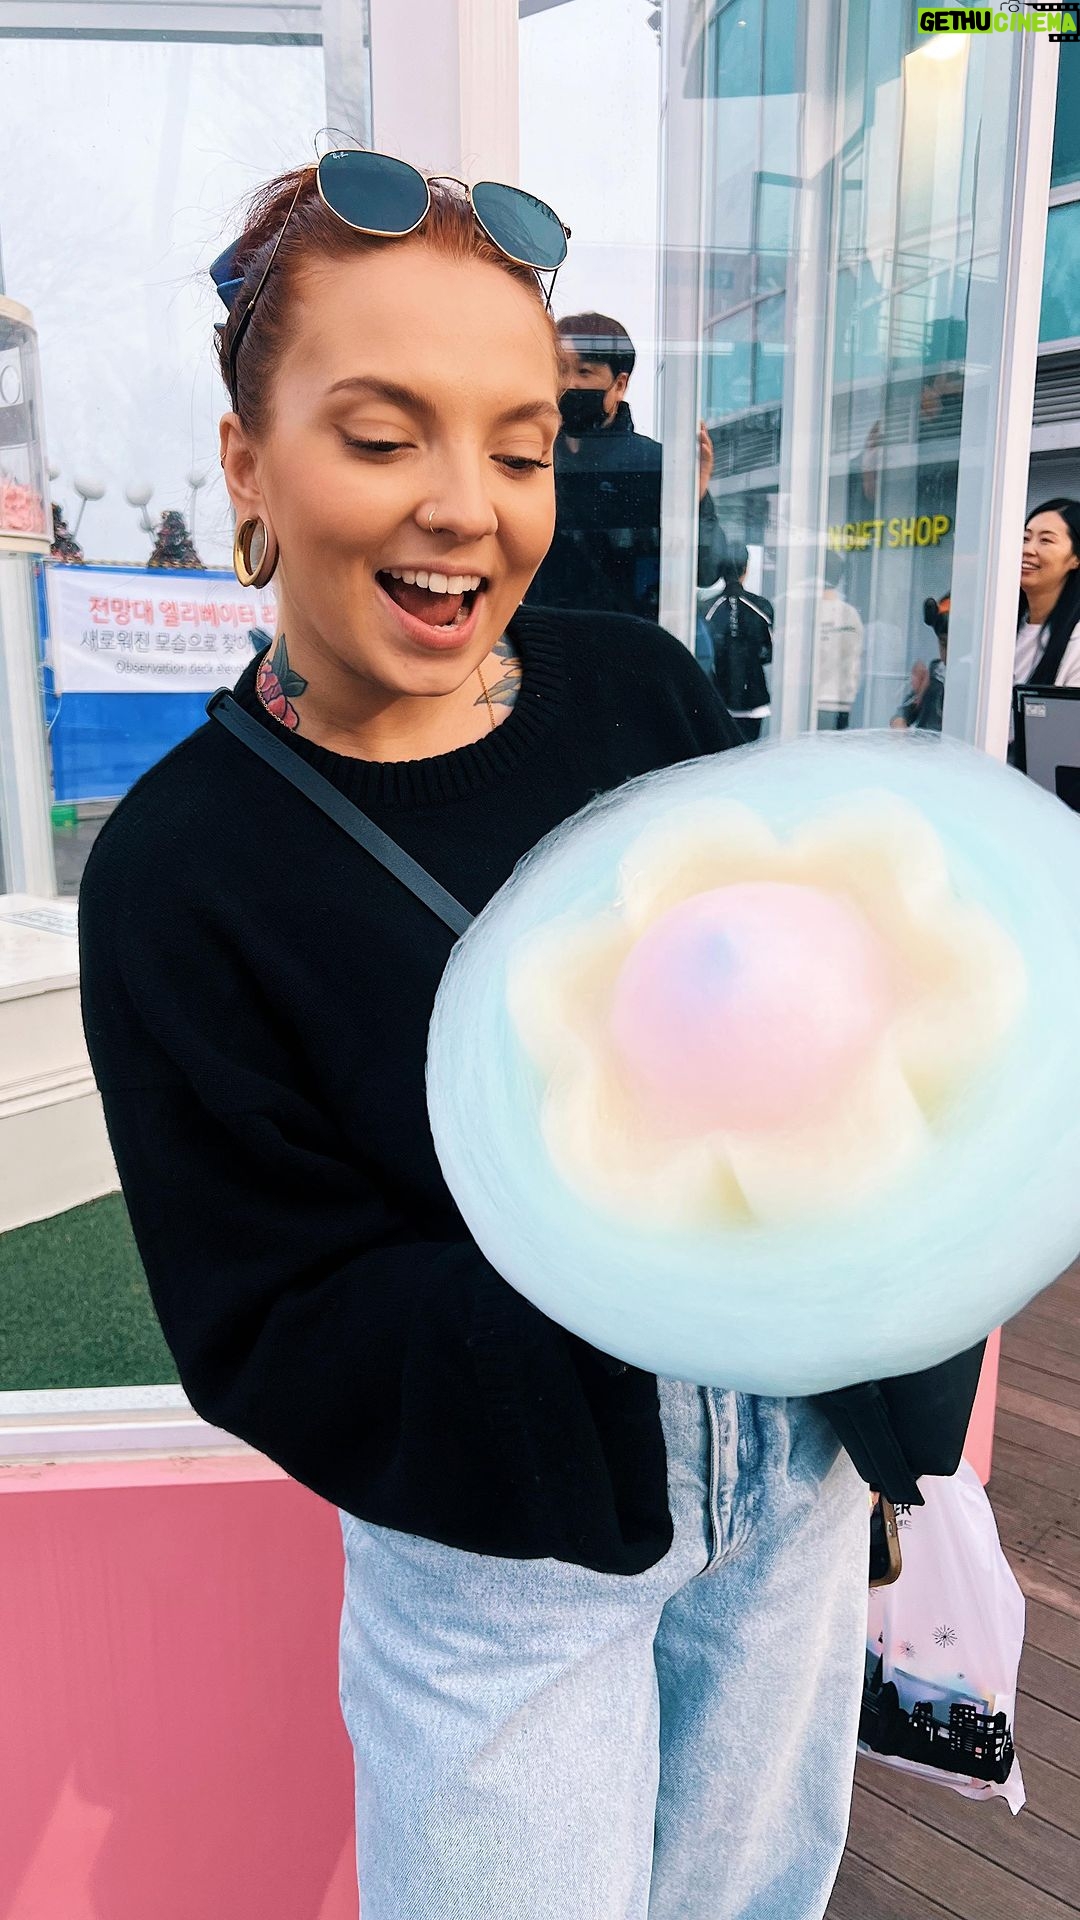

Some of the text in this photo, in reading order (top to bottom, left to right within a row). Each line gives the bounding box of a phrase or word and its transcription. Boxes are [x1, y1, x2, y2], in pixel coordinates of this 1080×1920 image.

[888, 514, 950, 547] SHOP
[88, 597, 153, 626] 전망대
[158, 601, 256, 628] 엘리베이터
[154, 632, 217, 654] 모습으로
[116, 660, 186, 675] Observation
